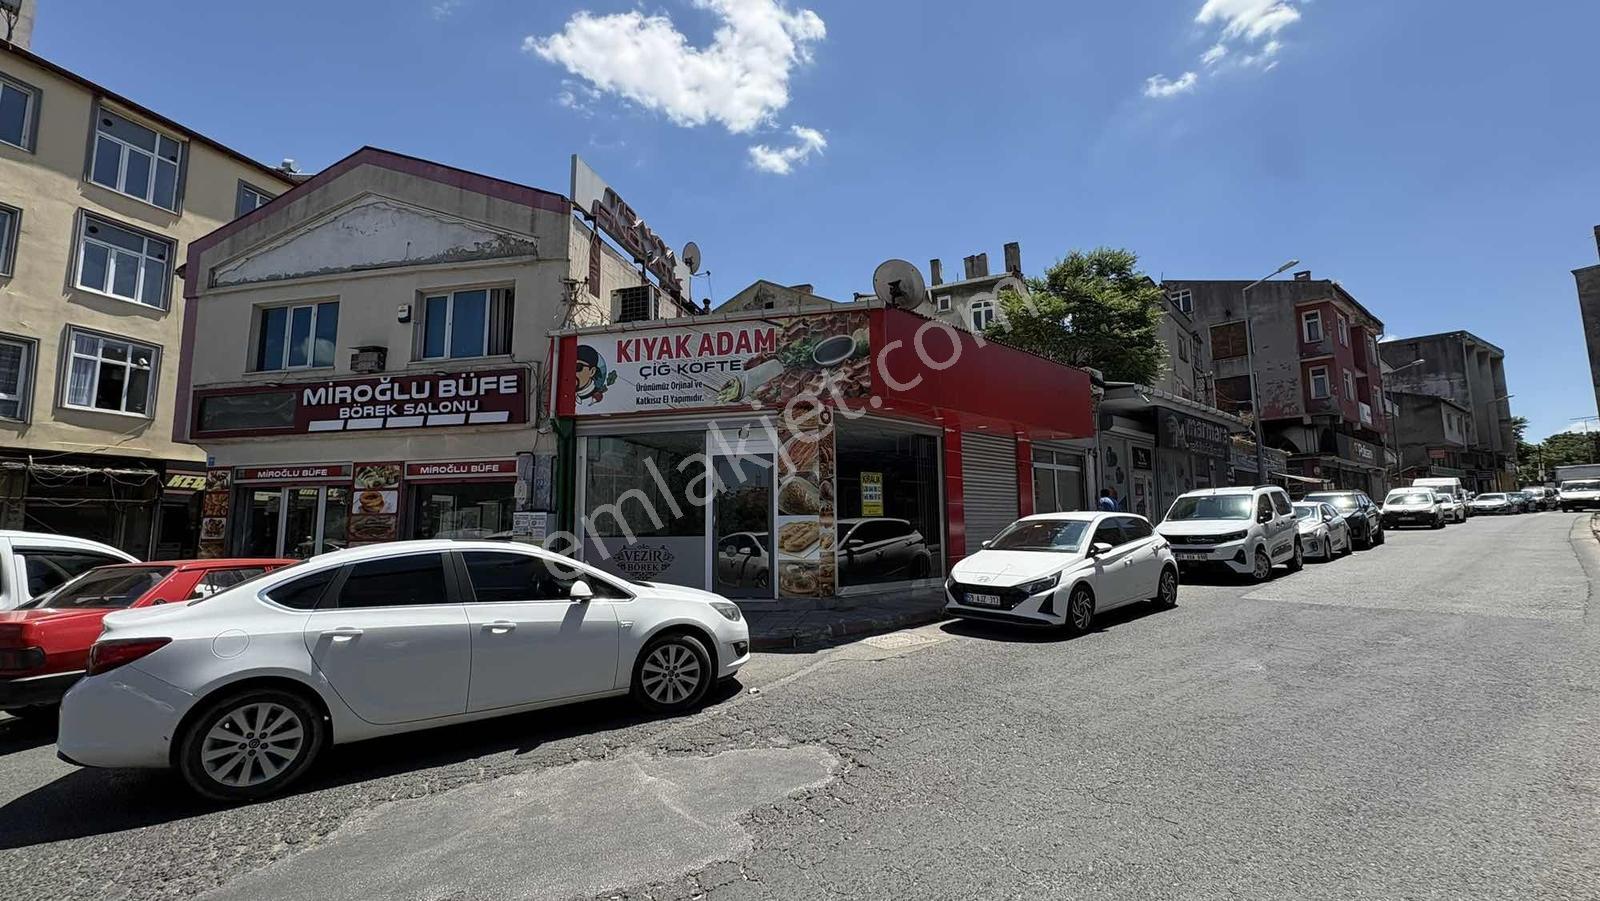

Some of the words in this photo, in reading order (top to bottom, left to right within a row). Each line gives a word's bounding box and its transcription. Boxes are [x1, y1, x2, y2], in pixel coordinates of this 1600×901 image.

[616, 334, 692, 364] KIYAK
[697, 327, 776, 358] ADAM
[639, 360, 671, 380] ÇİĞ
[302, 376, 431, 407] MİROĞLU
[438, 372, 518, 398] BÜFE
[635, 382, 669, 393] Ürünümüz
[694, 381, 703, 389] ve
[339, 403, 397, 419] BÖREK
[403, 399, 479, 416] SALONU
[257, 467, 300, 479] MİROĞLU
[301, 467, 328, 477] BÜFE
[419, 464, 467, 475] MİROĞLU
[470, 464, 500, 473] BÜFE
